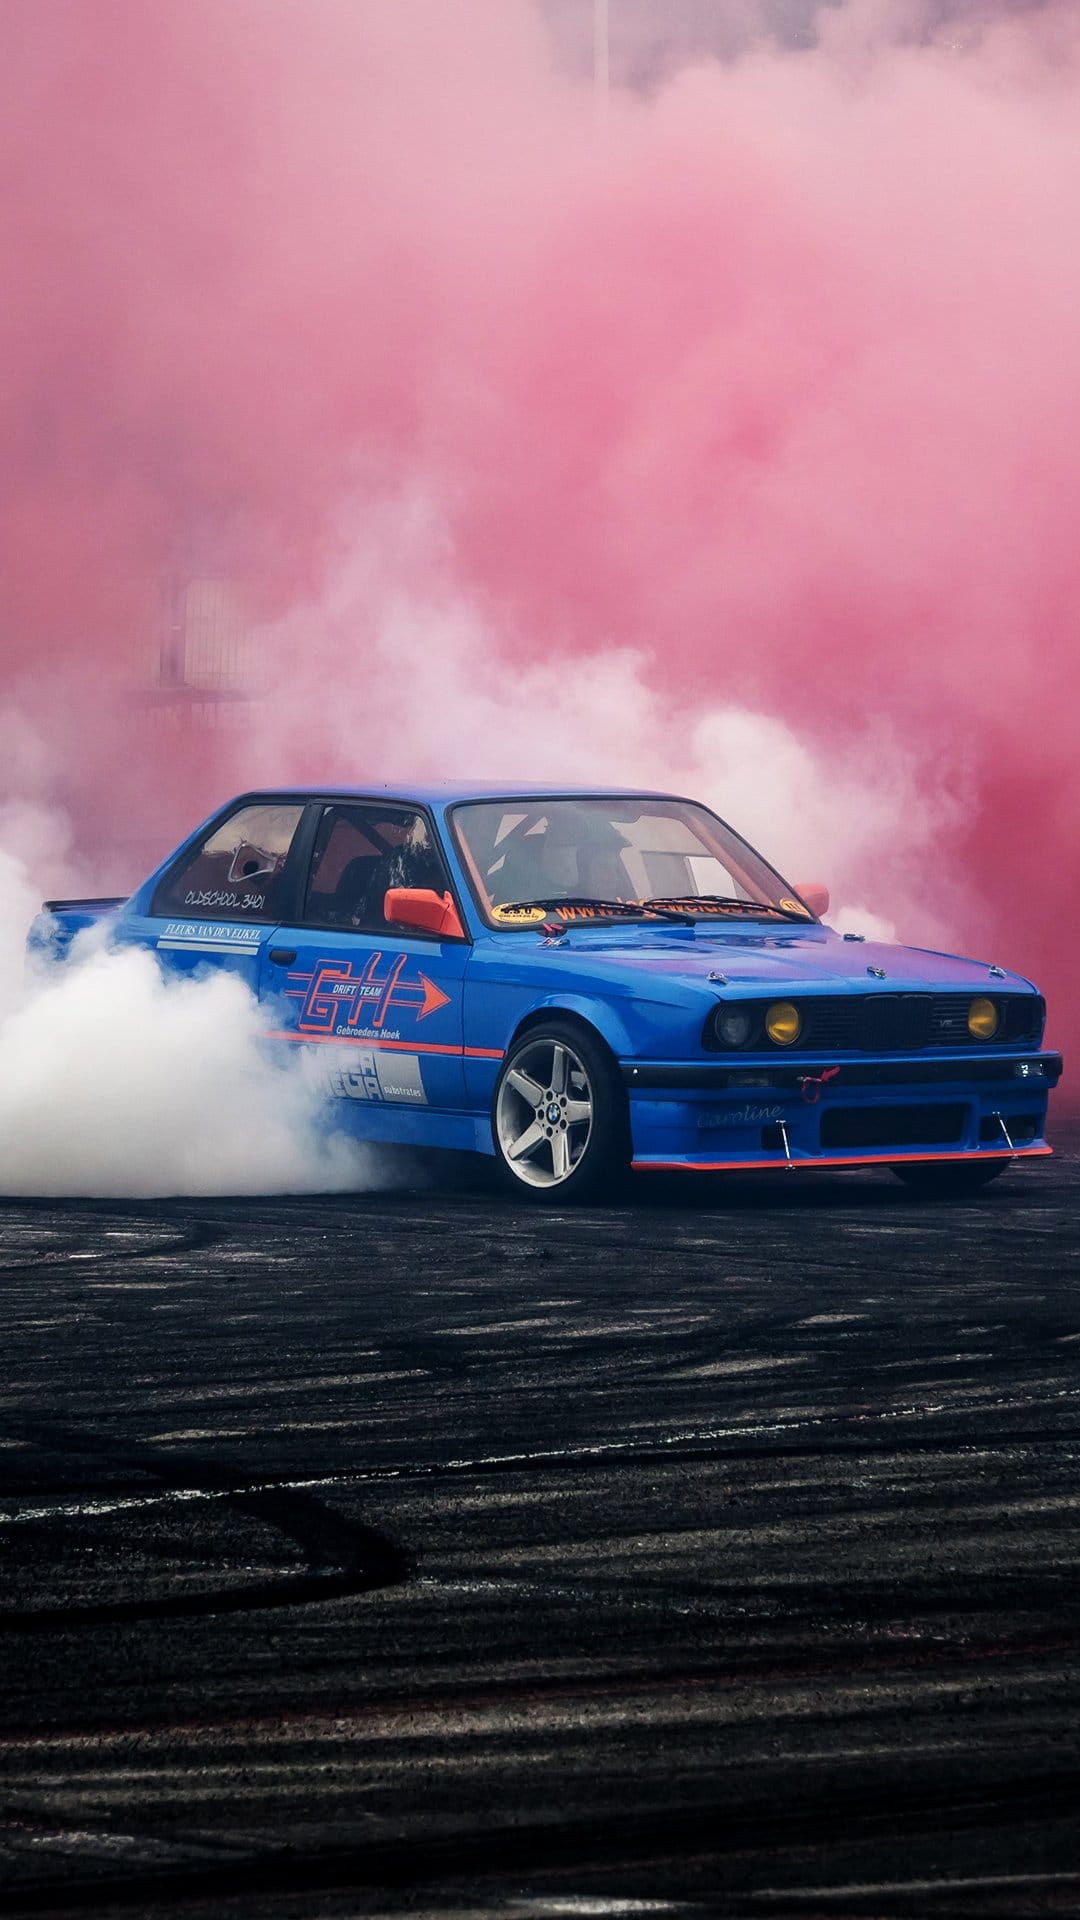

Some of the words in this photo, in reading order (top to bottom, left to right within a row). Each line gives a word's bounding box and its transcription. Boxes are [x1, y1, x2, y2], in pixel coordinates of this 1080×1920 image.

[184, 890, 241, 907] OLDSCHOOL
[165, 924, 196, 935] FLEURS
[198, 926, 214, 937] VAN
[213, 927, 231, 938] DEN
[333, 984, 357, 995] DRIFT
[360, 986, 382, 997] TEAM
[336, 1025, 379, 1038] Gebroeders
[380, 1029, 401, 1040] Hoek
[384, 1085, 421, 1097] substrates
[697, 1105, 784, 1128] Caroline
